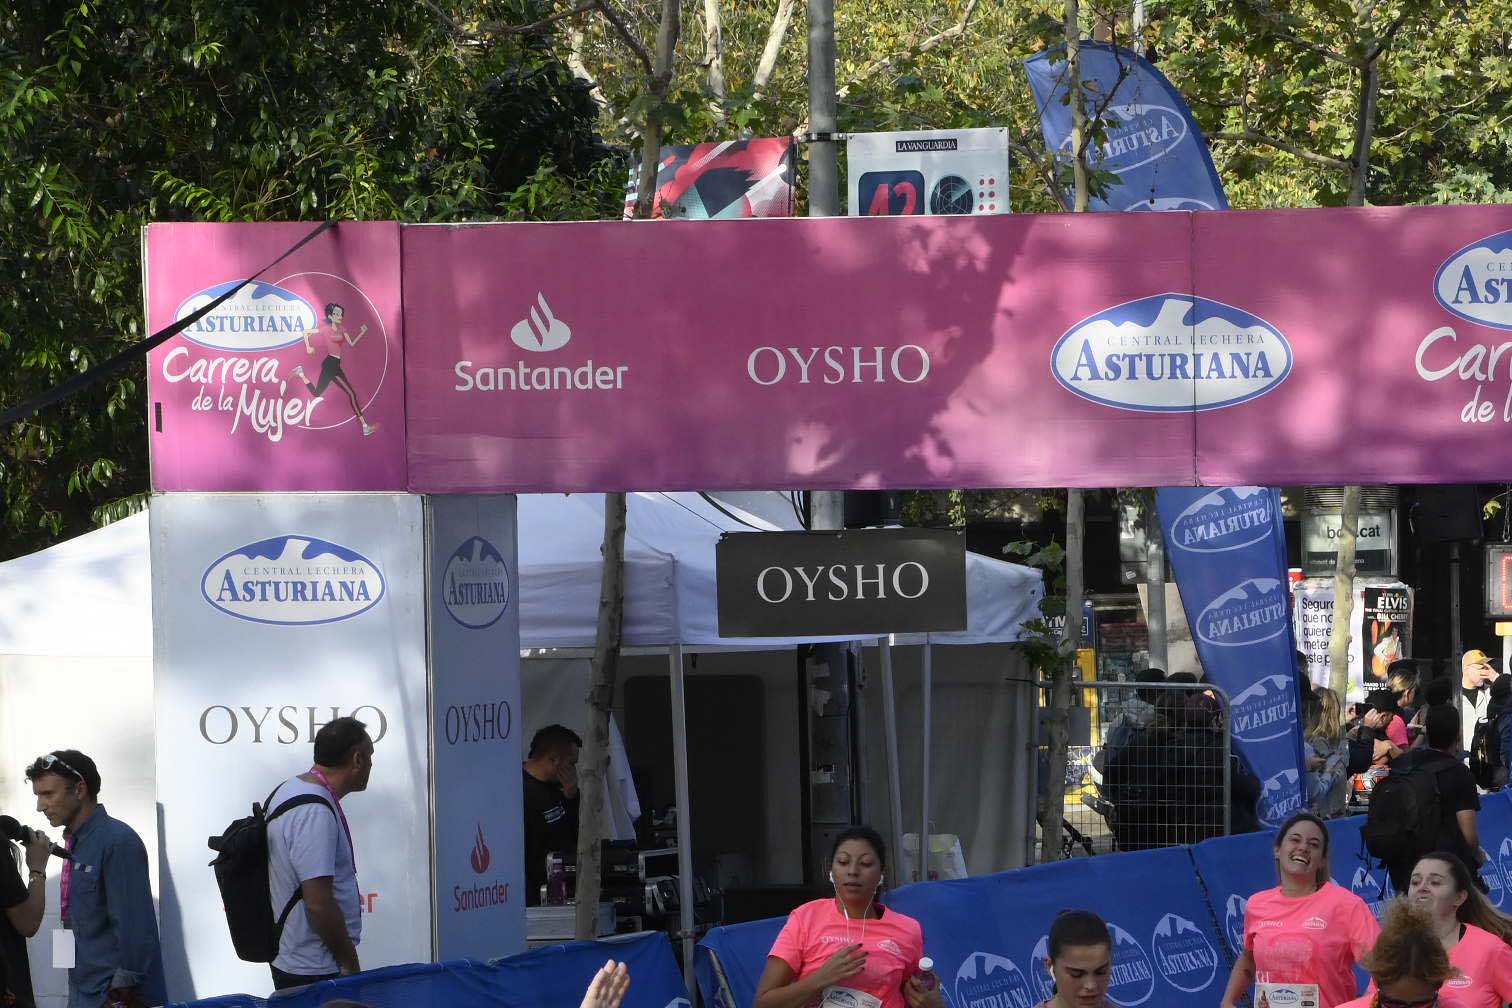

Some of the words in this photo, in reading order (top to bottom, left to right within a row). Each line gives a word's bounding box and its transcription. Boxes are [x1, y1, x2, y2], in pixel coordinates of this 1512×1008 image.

[907, 140, 956, 151] VANGUARDIA
[1107, 335, 1182, 346] CENTRAL
[1190, 334, 1265, 345] LECHERA
[163, 347, 279, 383] Carrera
[455, 360, 628, 391] Santander
[747, 344, 930, 385] OYSHO
[1070, 338, 1273, 381] ASTURIANA
[191, 385, 212, 411] de
[218, 385, 233, 411] la
[231, 381, 324, 442] Mujer
[1461, 385, 1494, 423] de
[1327, 524, 1380, 539] bc.cat
[216, 569, 371, 602] ASTURIANA
[244, 567, 300, 576] CENTRAL
[757, 561, 929, 603] OYSHO
[449, 578, 505, 606] ASTURIANA
[1377, 597, 1408, 609] ELVIS
[445, 700, 511, 745] OYSHO
[453, 880, 509, 912] Santander
